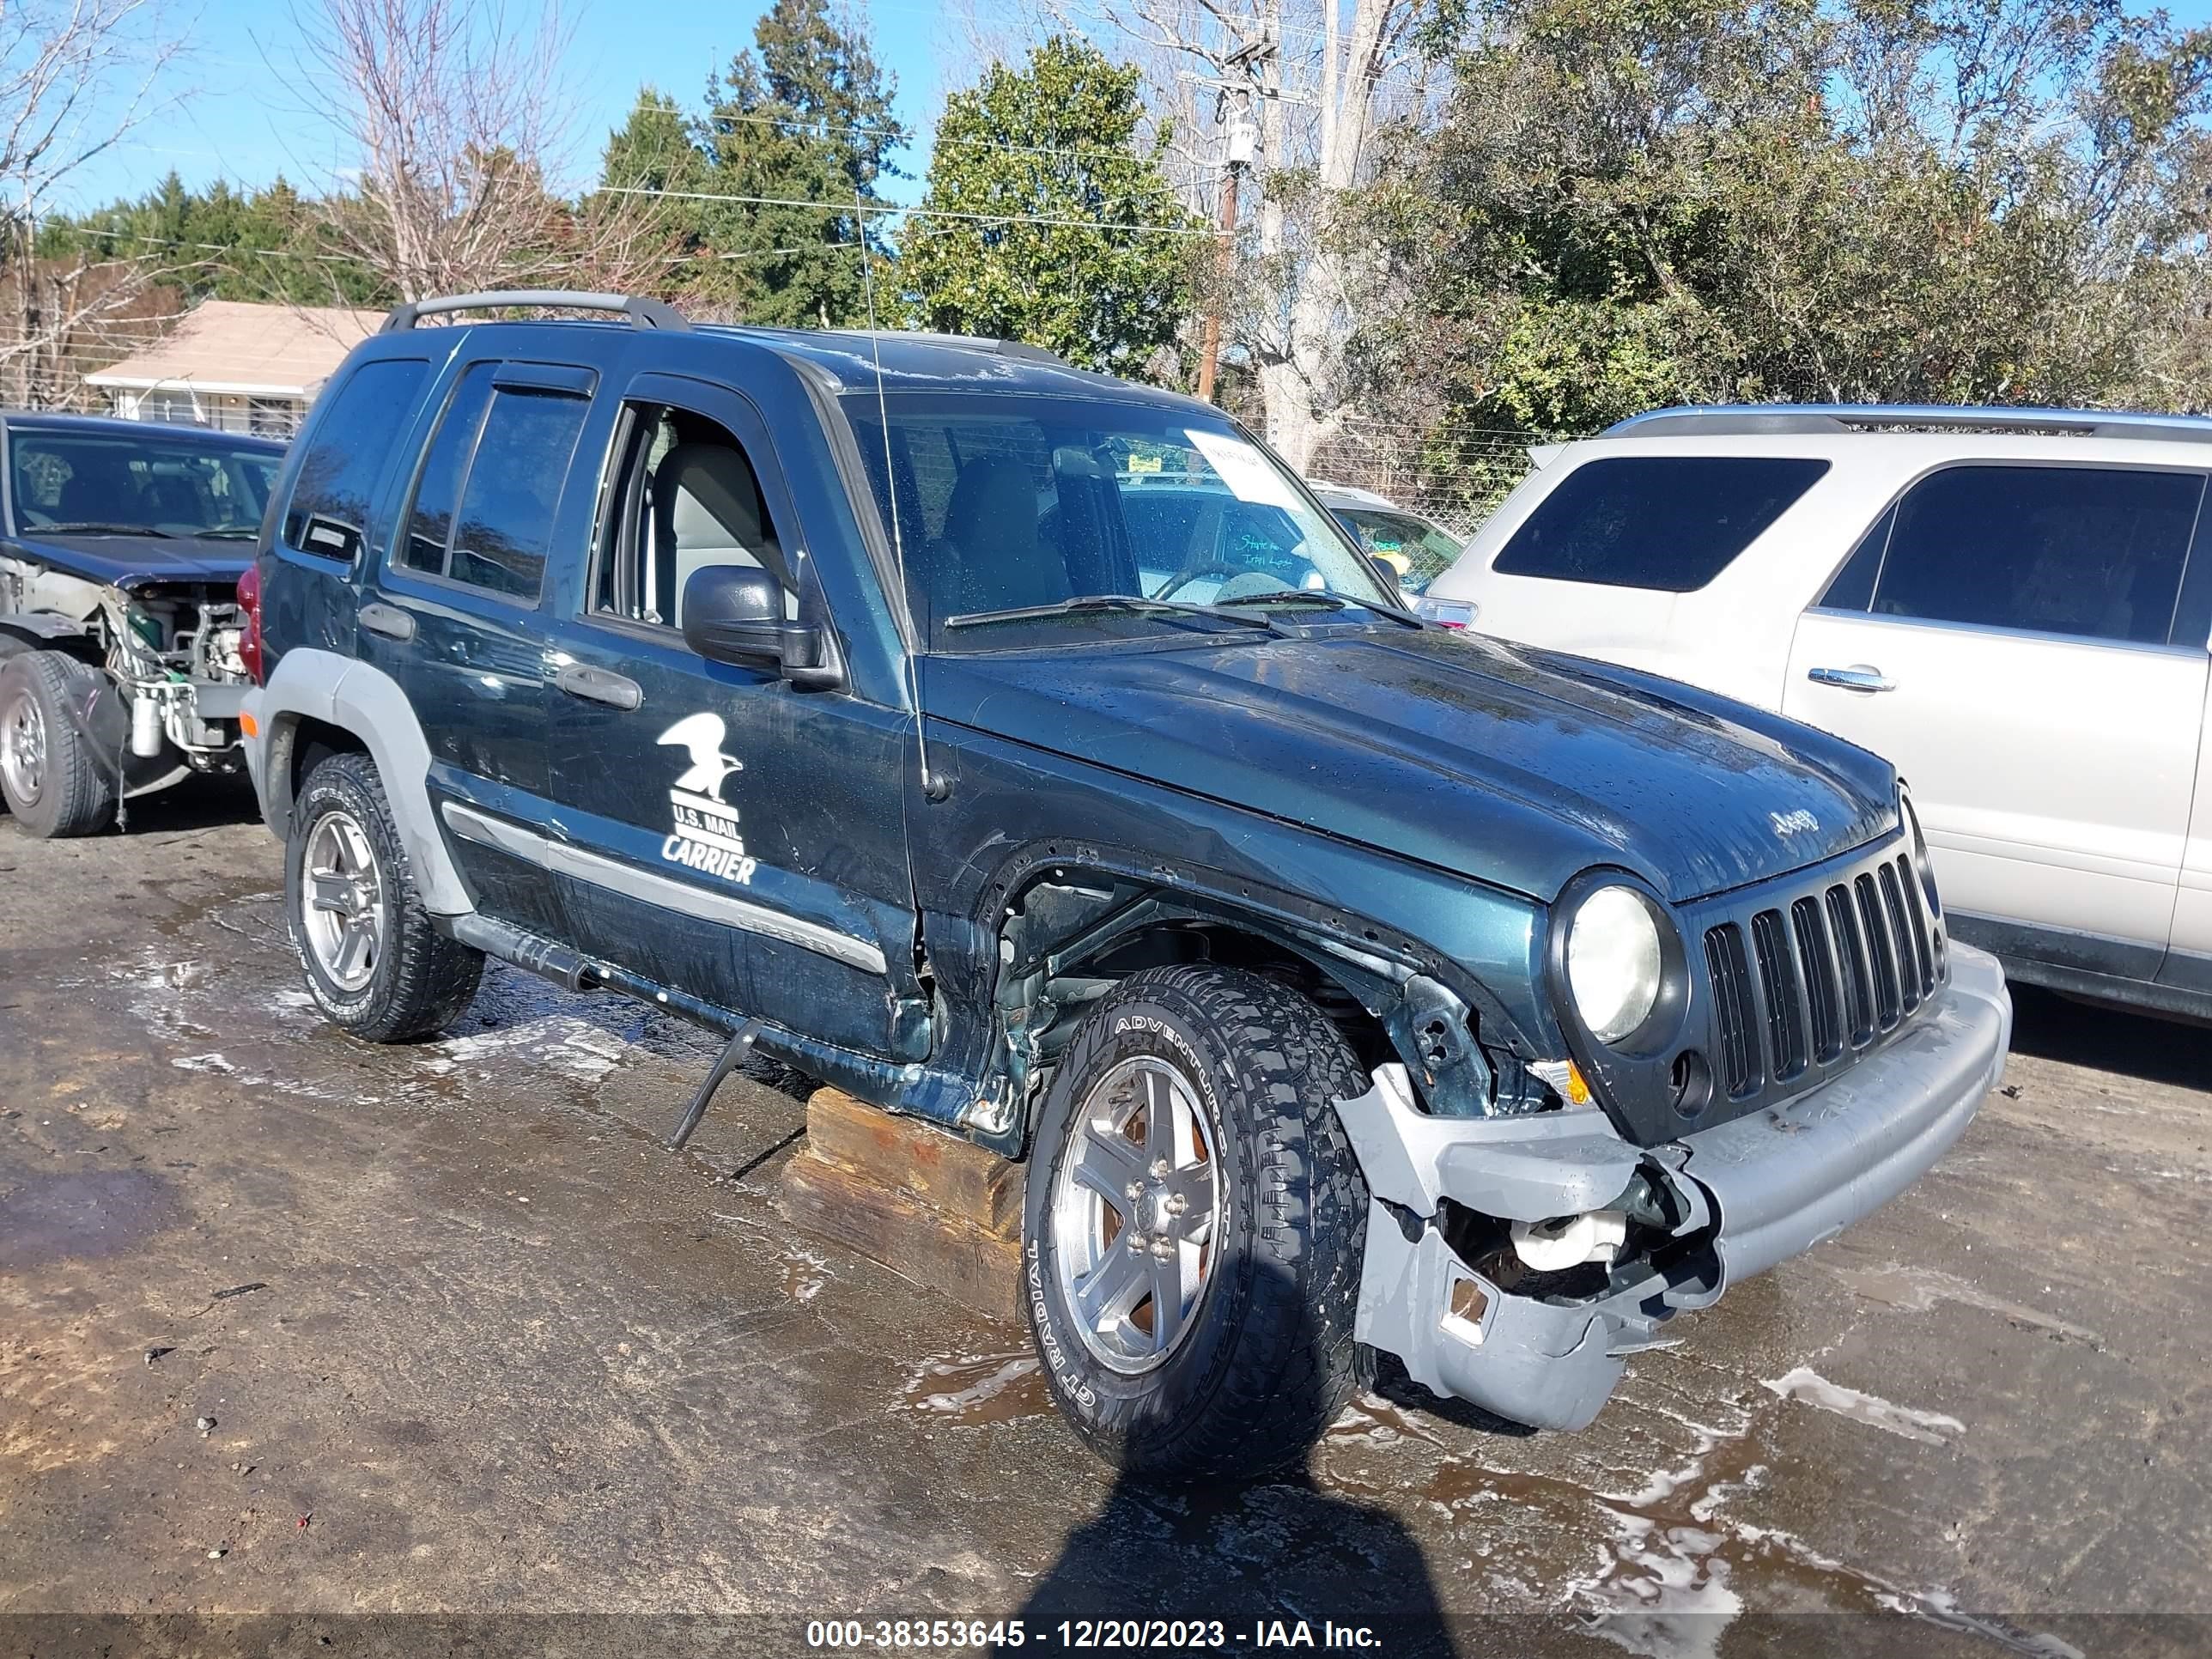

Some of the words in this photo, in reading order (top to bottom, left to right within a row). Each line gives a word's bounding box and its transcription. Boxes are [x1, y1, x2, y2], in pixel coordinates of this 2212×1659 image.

[672, 805, 702, 829] U.S.
[704, 813, 743, 842] MAIL
[661, 834, 757, 886] CARRIER
[1115, 1015, 1228, 1158] ADVENTURO
[1028, 1239, 1066, 1370] RADIAL
[1061, 1373, 1097, 1408] GT
